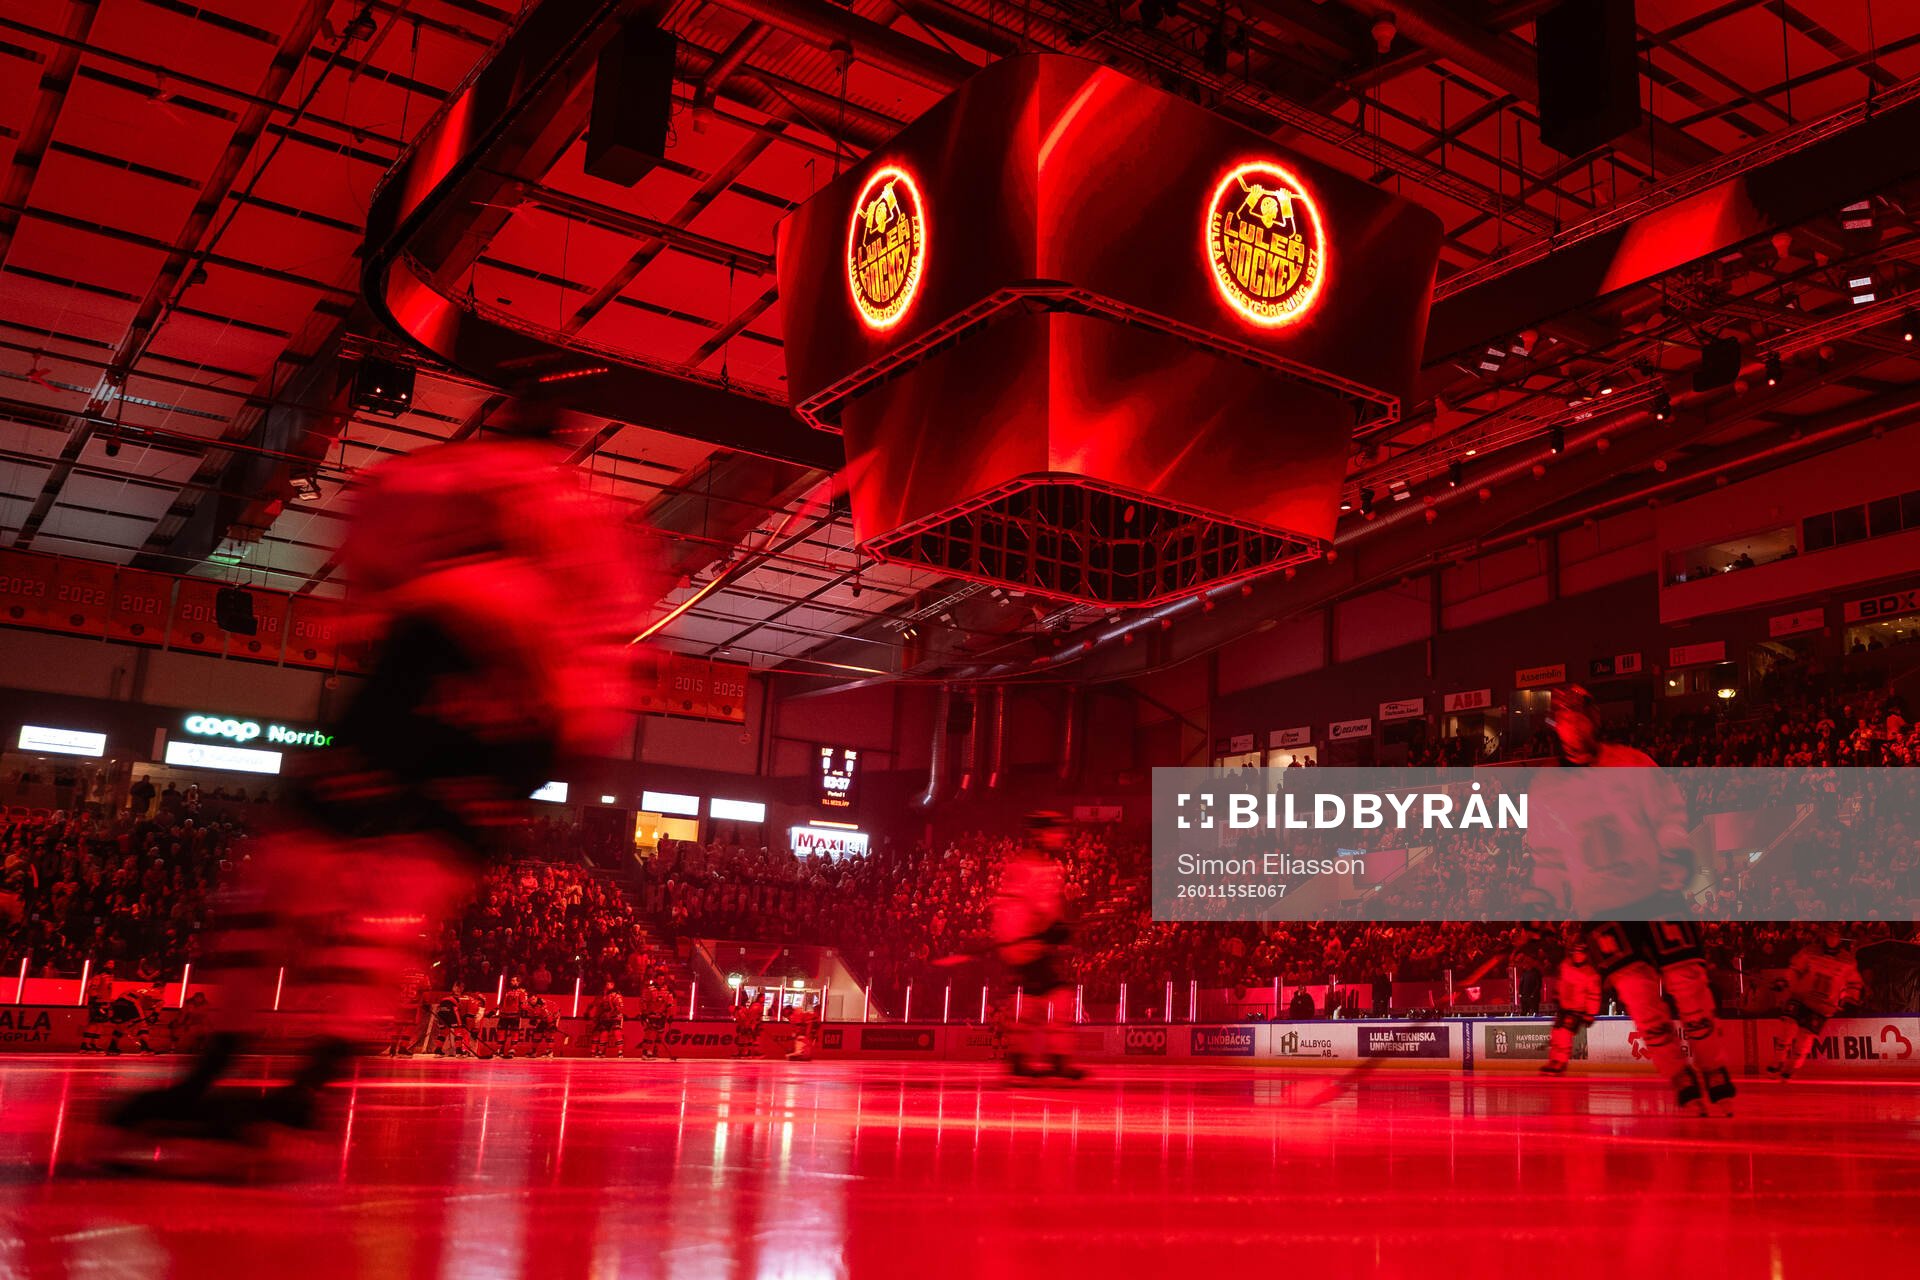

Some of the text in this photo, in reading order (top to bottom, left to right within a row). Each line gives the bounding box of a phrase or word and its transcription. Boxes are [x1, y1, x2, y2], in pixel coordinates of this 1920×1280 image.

[857, 213, 911, 270] LULEÅ
[1224, 212, 1305, 264] LULEÅ
[859, 240, 911, 303] HOCKEY
[1211, 212, 1318, 317] LULEÅ HOCKEYFÖRENING 1977
[1223, 236, 1302, 298] HOCKEY
[0, 576, 46, 596] 2023
[58, 584, 106, 605] 2022
[121, 594, 163, 614] 2021
[1860, 591, 1917, 617] BDX
[1453, 692, 1483, 709] ABB
[185, 715, 260, 742] coop
[798, 833, 845, 851] MAXI
[1127, 1031, 1165, 1051] coop
[1207, 1033, 1251, 1045] LINDBÄCKS
[1300, 1040, 1331, 1048] ALLBYGG
[1370, 1030, 1436, 1041] LULEÅ TEKNISKA
[1322, 1050, 1332, 1058] AB
[1370, 1042, 1420, 1051] UNIVERSITET
[1844, 1036, 1880, 1059] BIL
